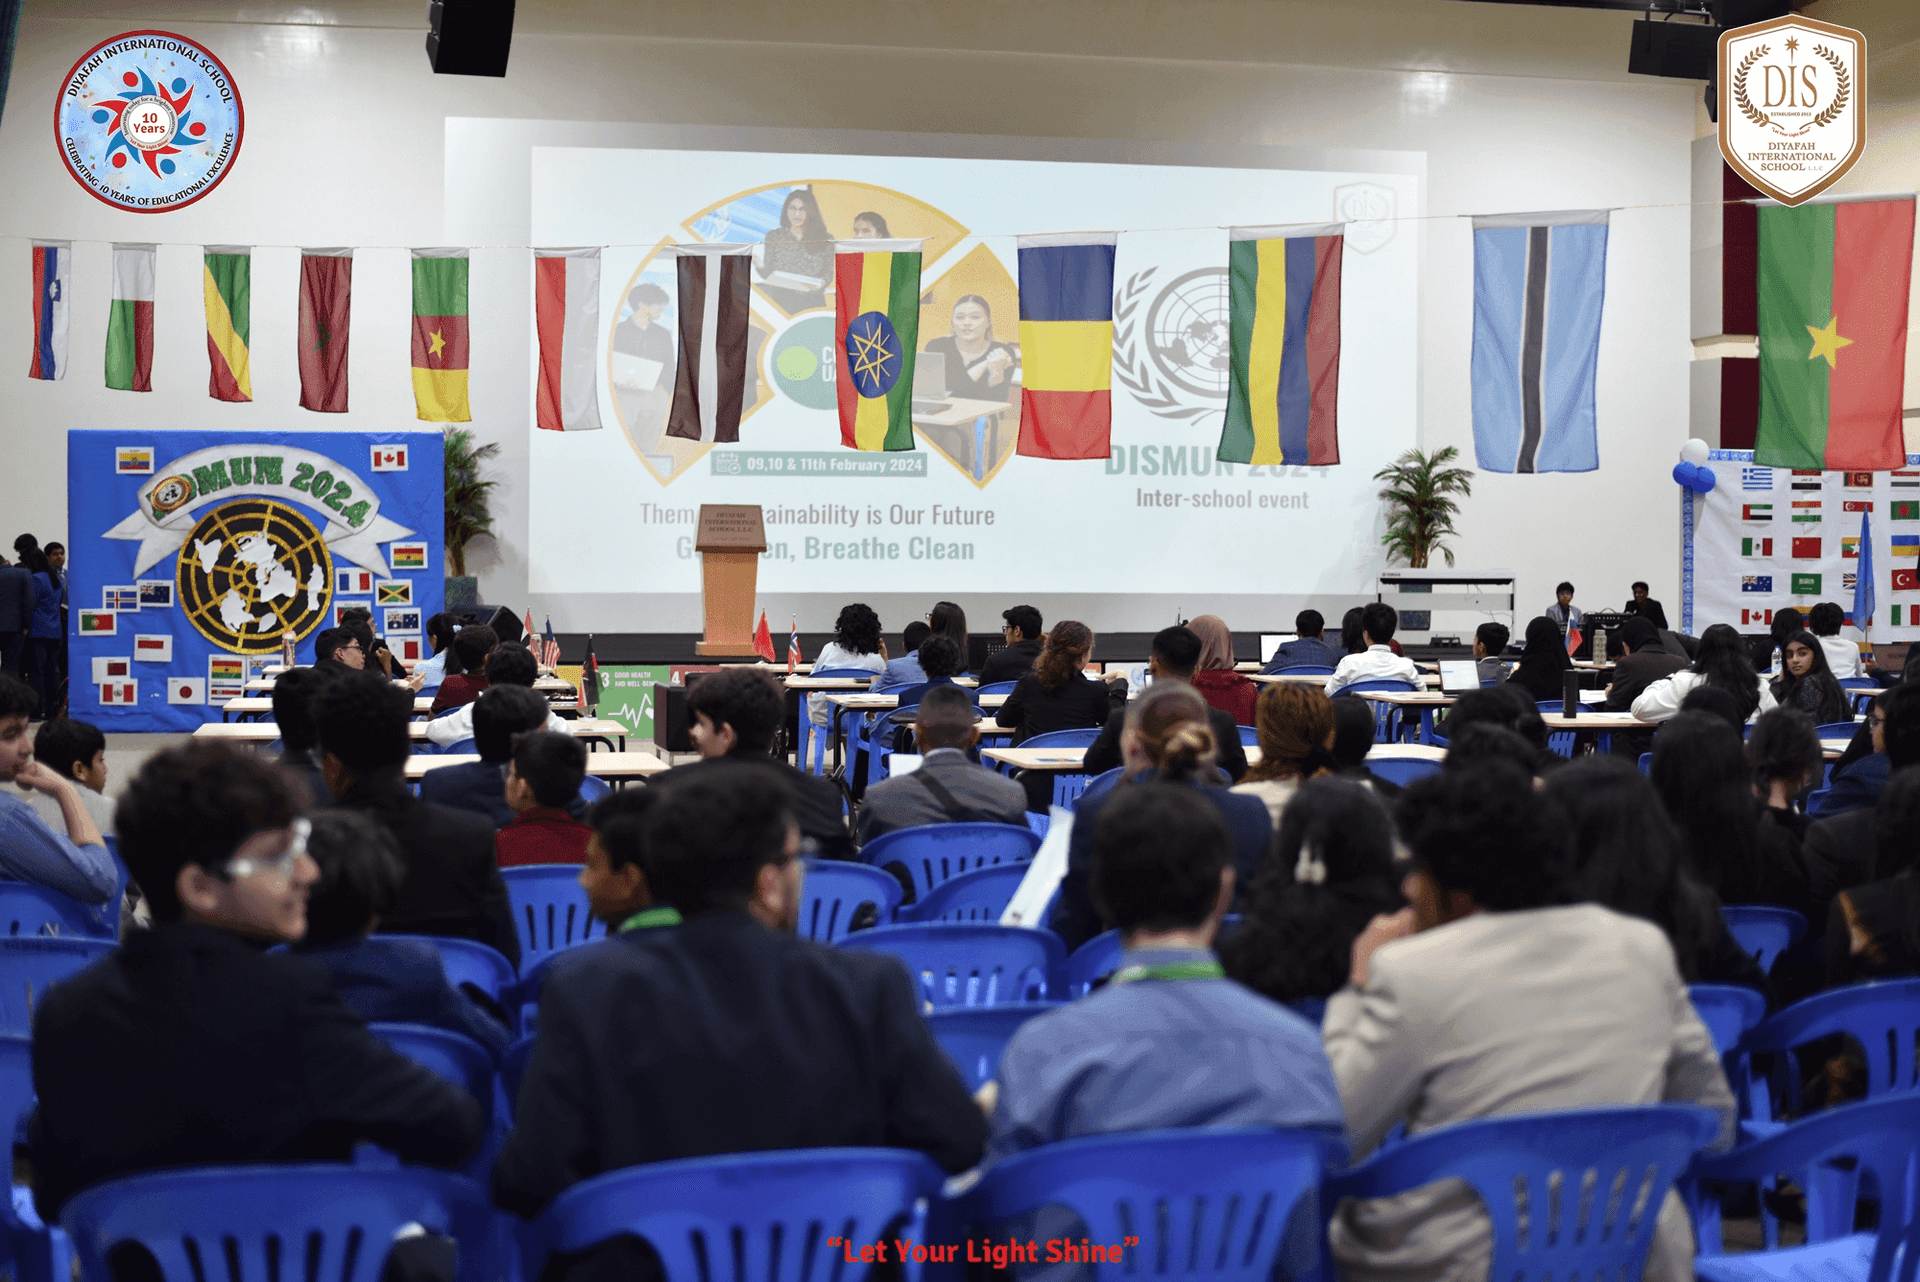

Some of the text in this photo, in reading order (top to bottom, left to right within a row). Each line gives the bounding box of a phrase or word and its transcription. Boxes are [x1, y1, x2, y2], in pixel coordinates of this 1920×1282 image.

[787, 457, 797, 471] &
[800, 457, 826, 471] 11th
[830, 458, 887, 473] February
[890, 458, 923, 471] 2024
[290, 462, 372, 528] 2024
[1136, 487, 1310, 510] Inter-school event
[640, 503, 698, 525] Them
[867, 504, 882, 525] is
[889, 504, 925, 525] Our
[932, 504, 995, 525] Future
[804, 536, 900, 560] Breathe
[908, 536, 974, 560] Clean
[601, 671, 610, 688] 3
[671, 671, 681, 684] 4
